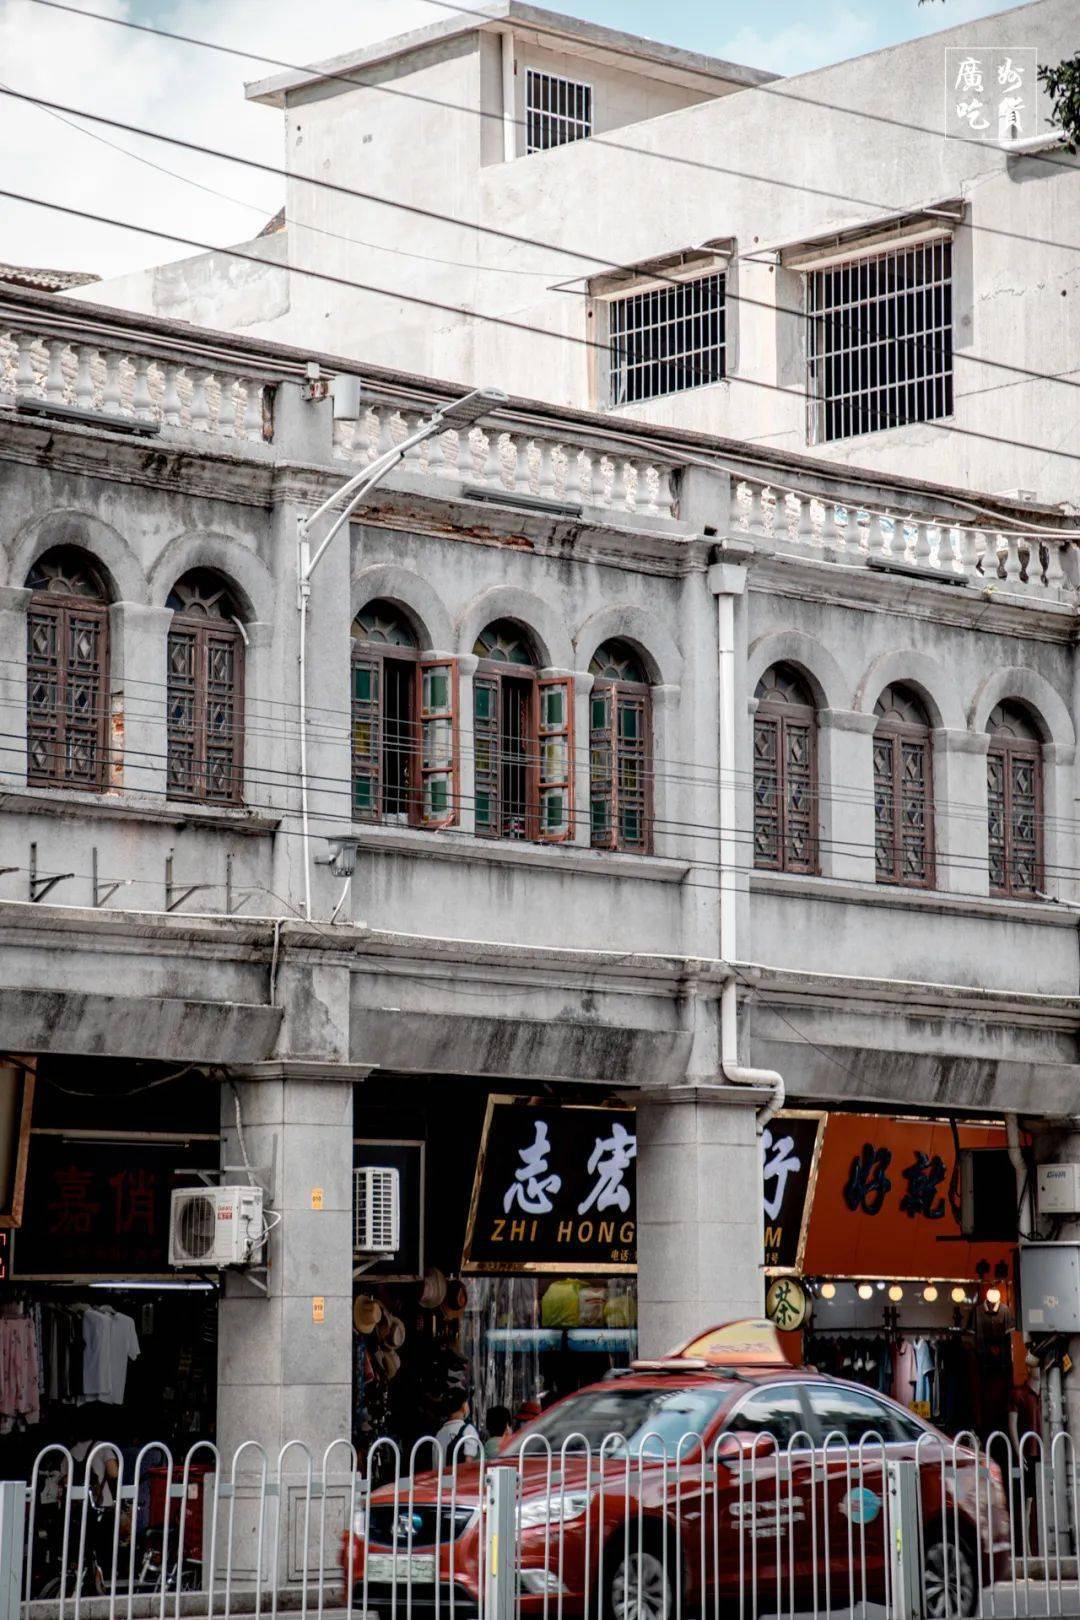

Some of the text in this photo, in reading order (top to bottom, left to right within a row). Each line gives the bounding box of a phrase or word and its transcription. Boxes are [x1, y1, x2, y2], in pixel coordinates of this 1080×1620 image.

[503, 1121, 637, 1216] 志宏
[490, 1219, 538, 1242] ZHI
[557, 1220, 636, 1244] HONG
[770, 1281, 800, 1325] 茶
